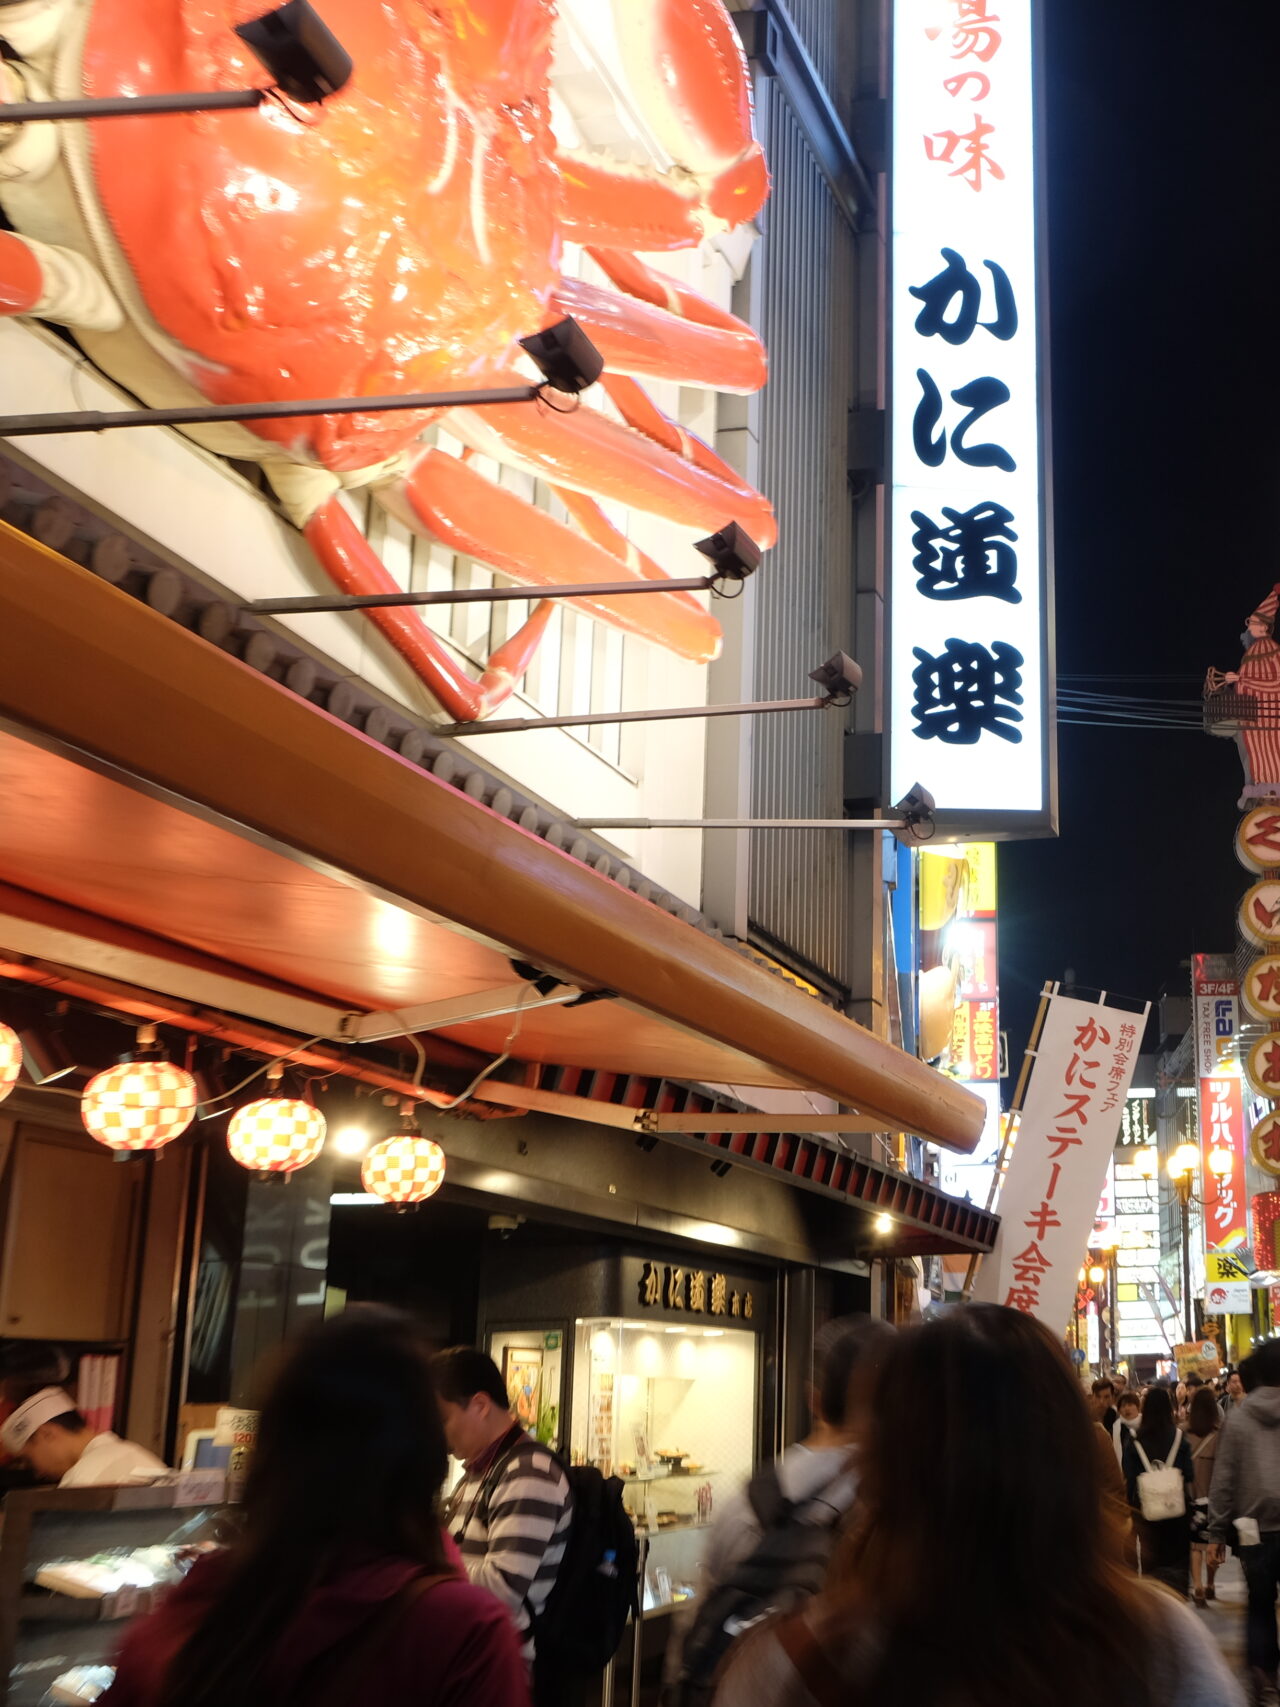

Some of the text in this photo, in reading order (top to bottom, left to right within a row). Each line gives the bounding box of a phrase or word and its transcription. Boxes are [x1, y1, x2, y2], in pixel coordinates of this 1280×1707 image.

[1200, 983, 1235, 995] 3F/4F
[1202, 1002, 1213, 1074] TAX FREE SHOP
